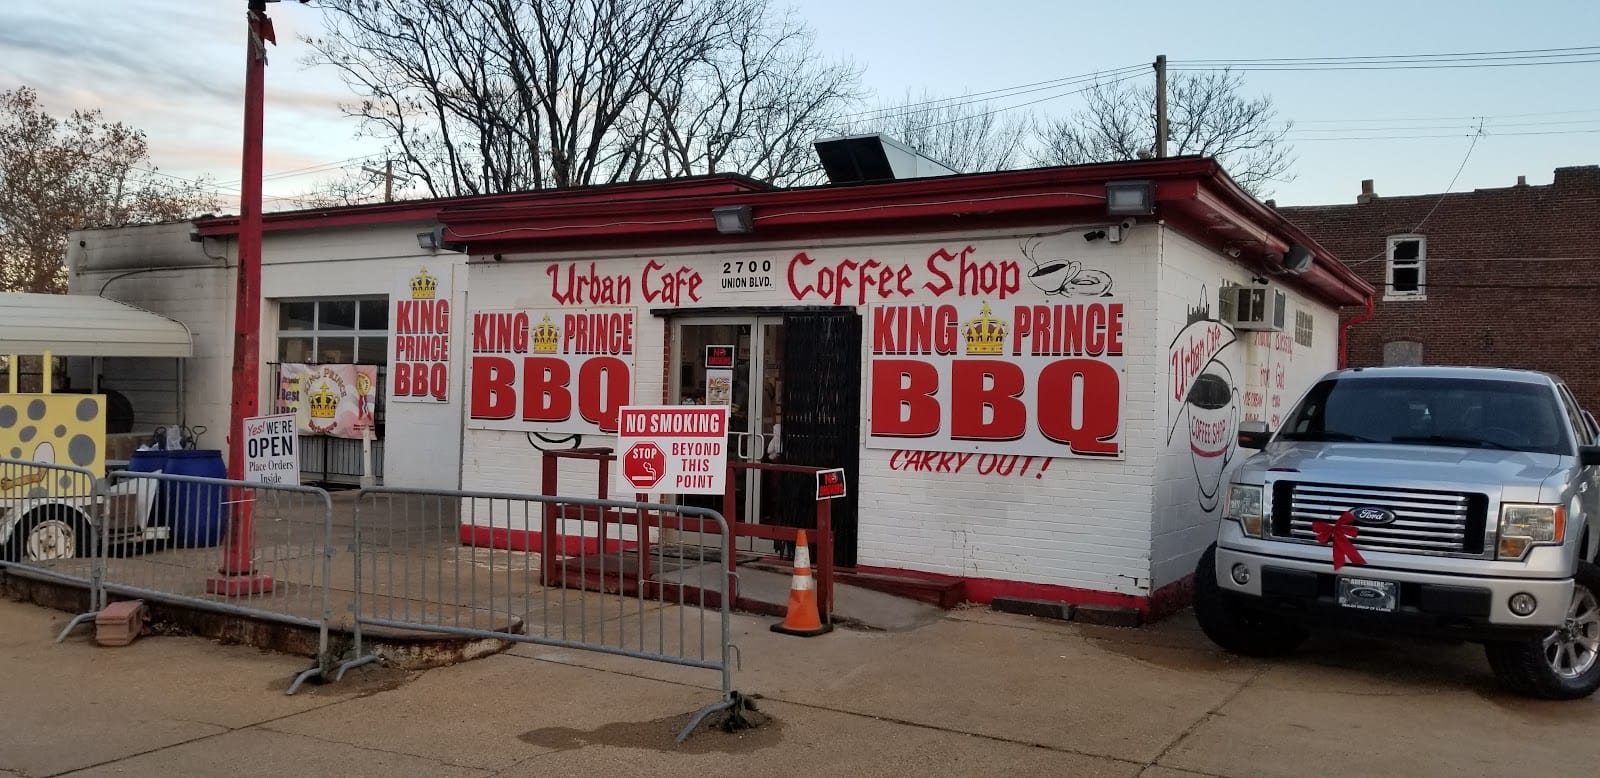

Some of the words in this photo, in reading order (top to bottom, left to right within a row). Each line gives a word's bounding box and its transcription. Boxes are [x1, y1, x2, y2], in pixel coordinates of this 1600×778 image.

[723, 260, 771, 274] 2700
[787, 252, 914, 305] Coffee
[922, 245, 1021, 300] Shop
[546, 262, 632, 305] Urban
[641, 259, 703, 307] Cafe
[721, 277, 747, 289] UNION
[749, 276, 772, 288] BLVD.
[397, 299, 449, 334] KING
[473, 312, 529, 353] KING
[563, 313, 632, 355] PRINCE
[873, 304, 958, 356] KING
[1012, 303, 1123, 357] PRINCE
[396, 335, 449, 361] PRINCE
[1172, 335, 1205, 402] Urban
[1206, 324, 1222, 357] Cafe
[324, 367, 347, 398] PRINCE
[393, 362, 447, 401] BBQ
[281, 388, 300, 402] Best
[471, 357, 630, 433] BBQ
[871, 358, 1120, 457] BBQ
[248, 421, 265, 436] Yes!
[267, 420, 293, 434] WE'RE
[626, 413, 647, 433] NO
[650, 413, 720, 433] SMOKING
[1191, 415, 1211, 444] COFFEE
[1212, 419, 1226, 445] SHOP
[249, 436, 293, 458] OPEN
[632, 447, 657, 459] STOP
[672, 443, 720, 456] BEYOND
[249, 461, 267, 472] Place
[268, 460, 294, 470] Orders
[681, 459, 710, 472] THIS
[889, 450, 973, 473] CARRY
[260, 473, 282, 484] Inside
[676, 475, 714, 488] POINT
[1360, 509, 1385, 520] Ford
